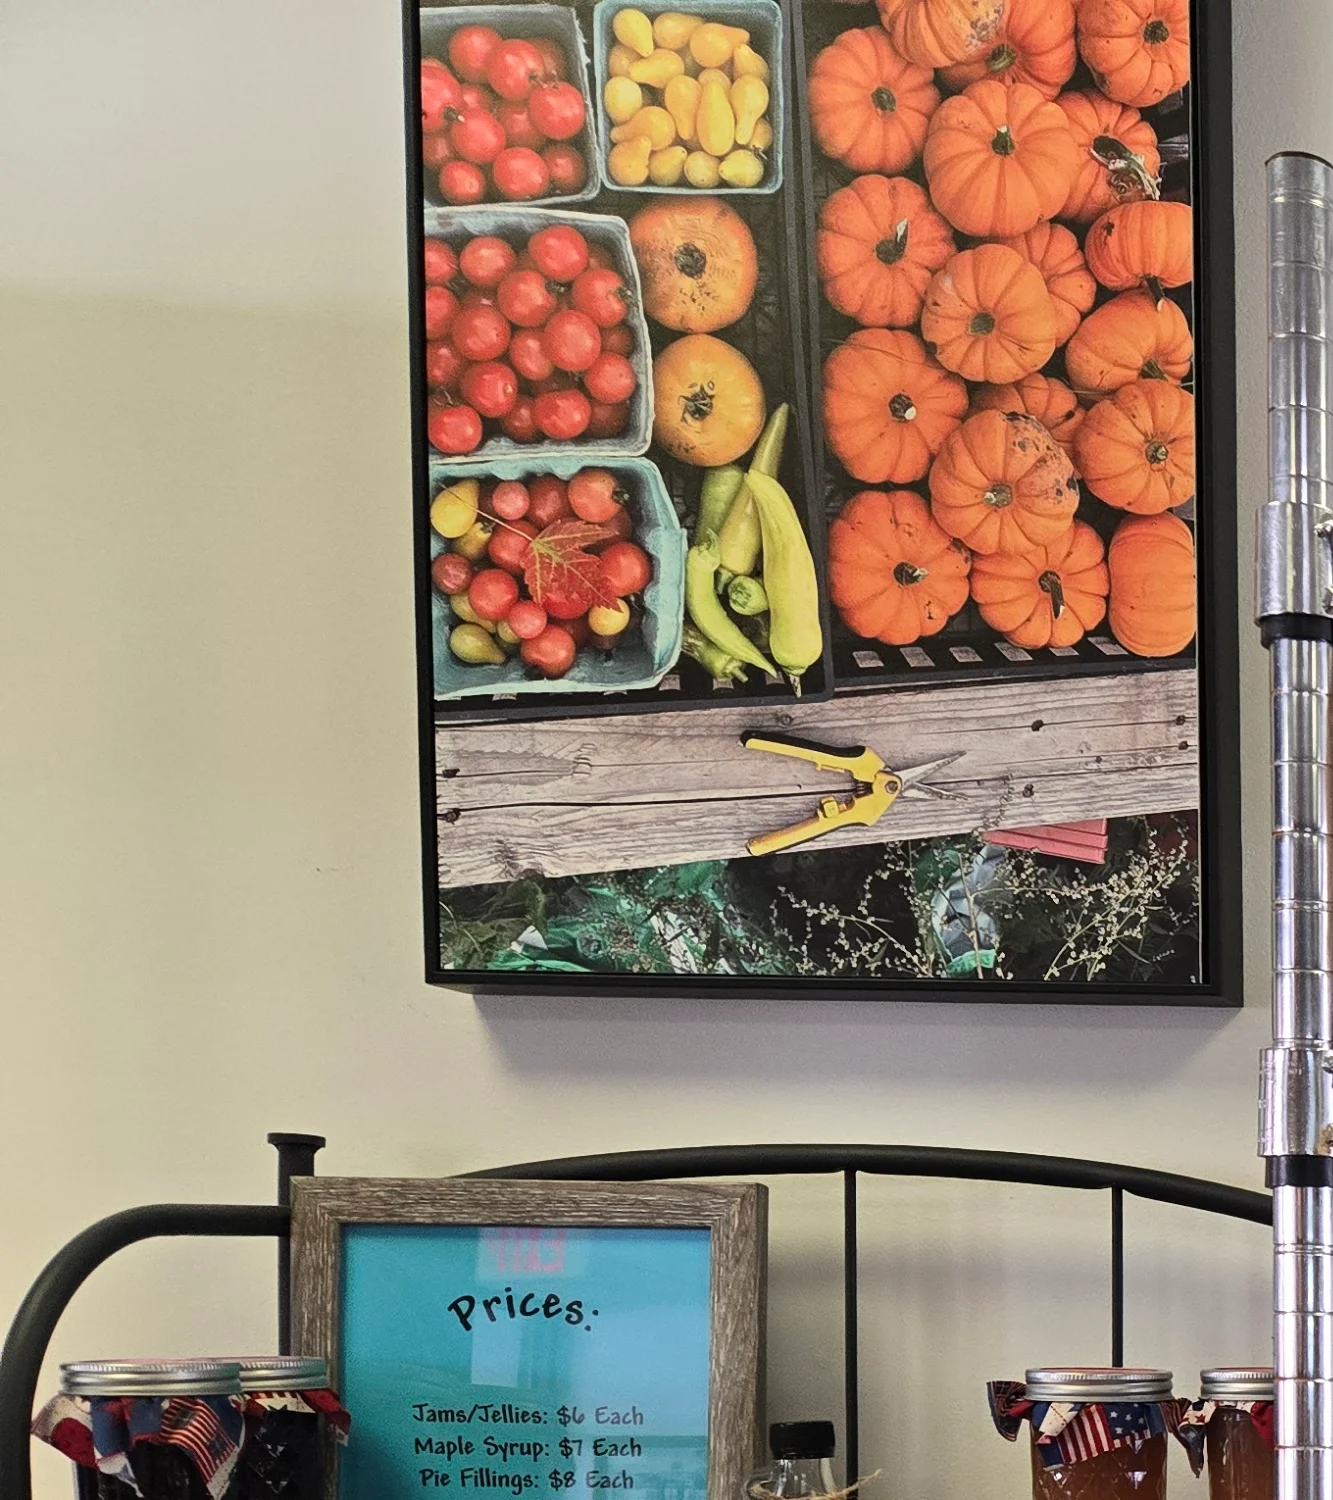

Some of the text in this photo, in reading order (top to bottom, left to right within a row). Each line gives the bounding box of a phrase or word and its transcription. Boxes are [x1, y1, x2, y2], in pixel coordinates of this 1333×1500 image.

[448, 1287, 599, 1332] Prices:
[411, 1403, 645, 1427] Jams/Jellies: $6 Each
[414, 1438, 643, 1462] Maple Syrup: $7 Each
[420, 1469, 634, 1496] Pie Fillings: $8 Each
